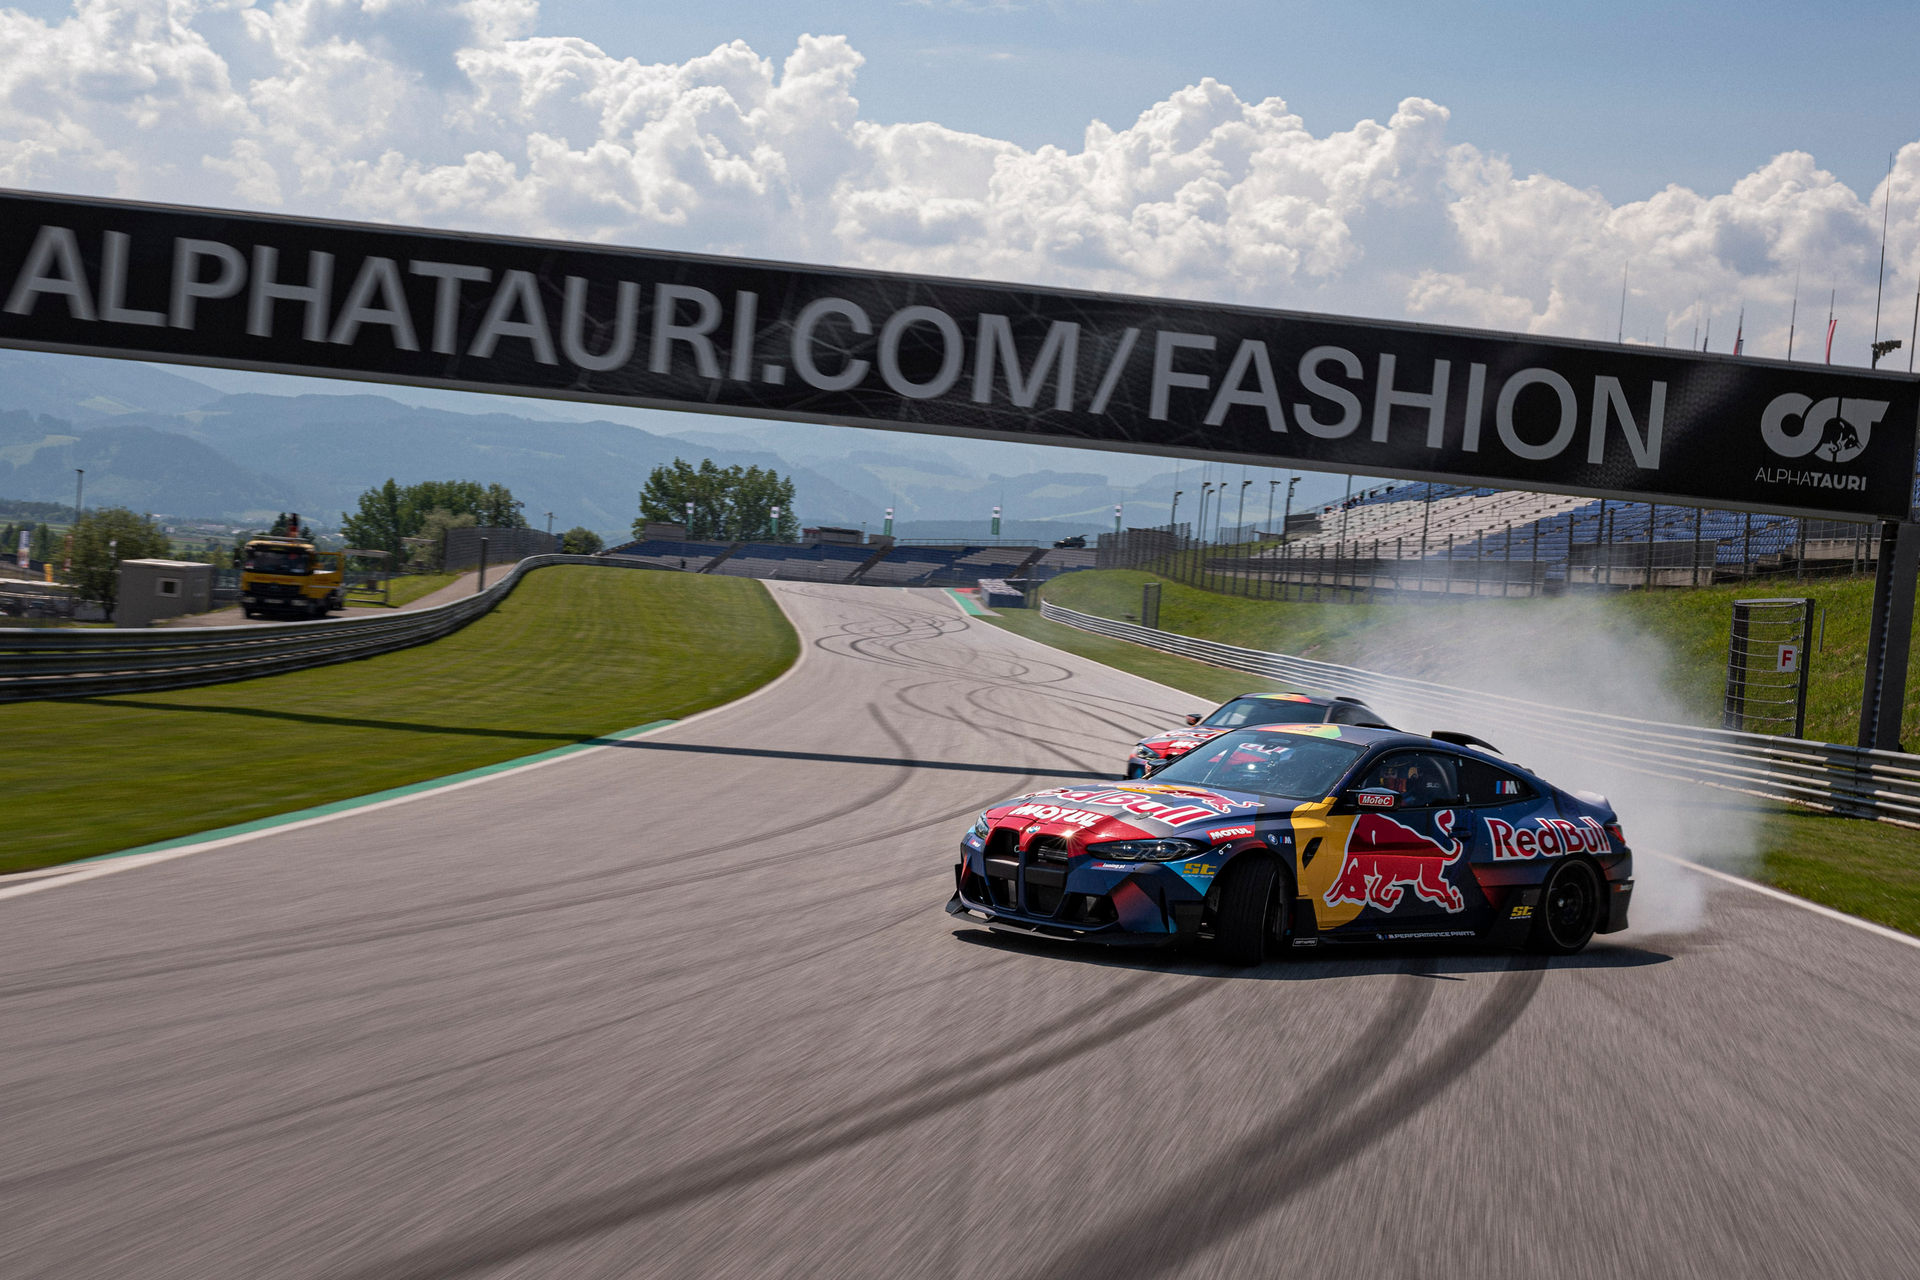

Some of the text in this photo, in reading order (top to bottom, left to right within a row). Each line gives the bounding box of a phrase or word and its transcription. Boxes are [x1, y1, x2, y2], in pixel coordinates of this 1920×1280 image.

[4, 224, 1667, 471] ALPHATAURI.COM/FASHION
[1755, 466, 1867, 491] ALPHATAURI
[1781, 649, 1793, 667] F
[1086, 790, 1220, 827] Bull
[1360, 795, 1391, 805] MoTeC
[1009, 804, 1104, 828] MOTUL
[1209, 827, 1252, 840] MOTUL
[1483, 815, 1612, 861] Red Bull
